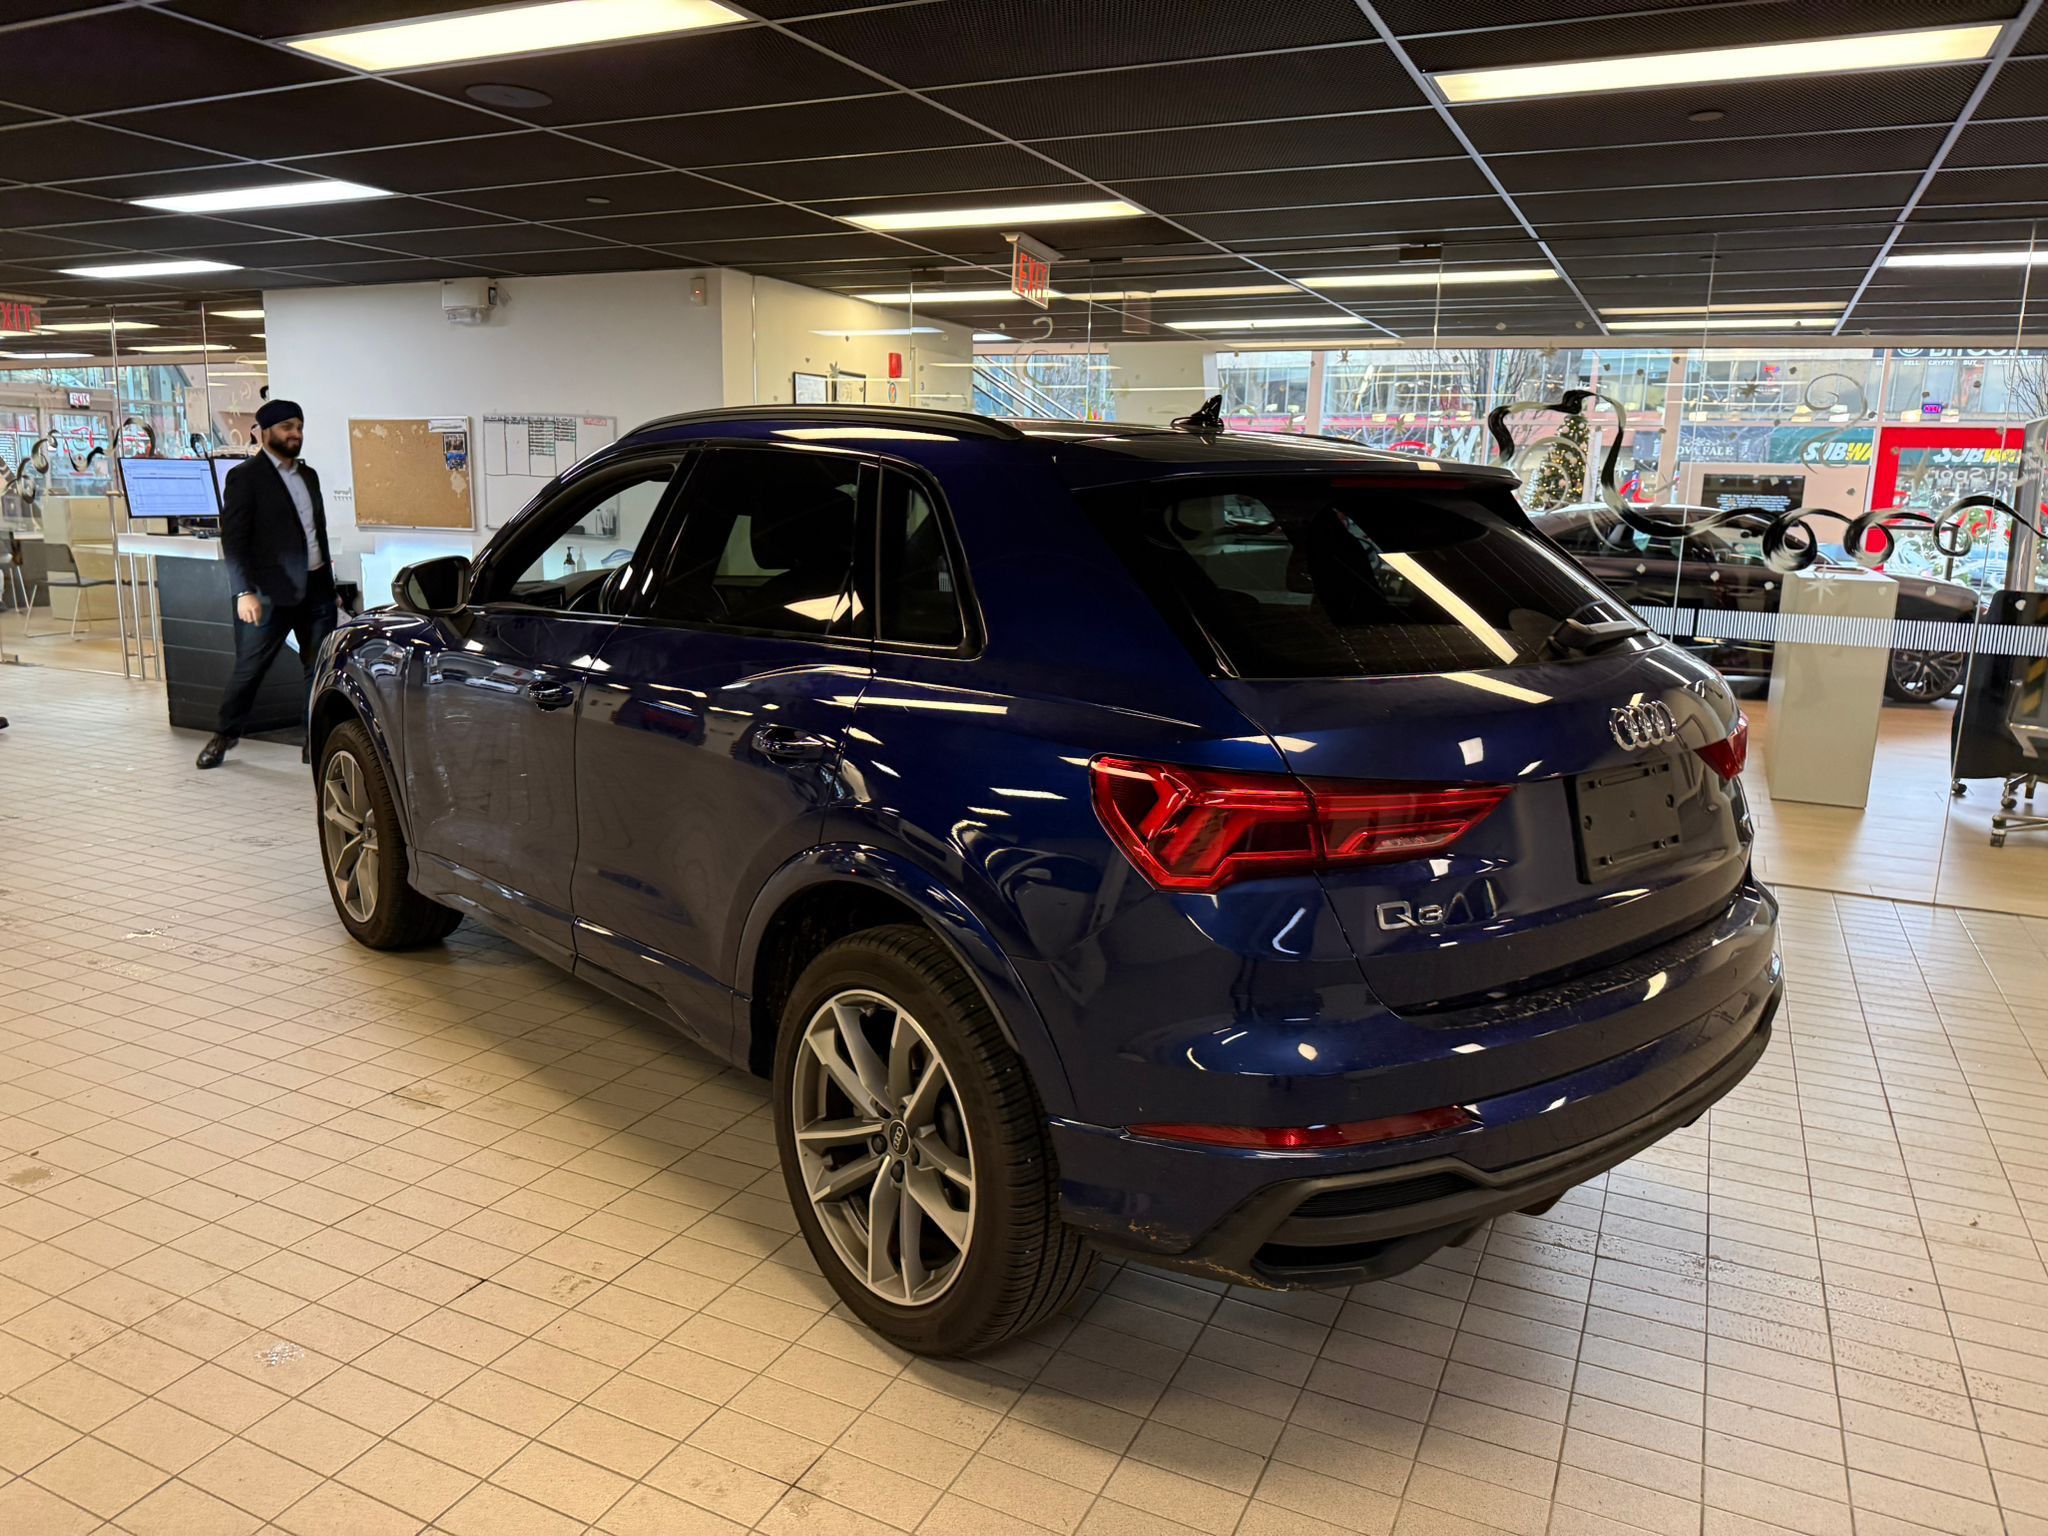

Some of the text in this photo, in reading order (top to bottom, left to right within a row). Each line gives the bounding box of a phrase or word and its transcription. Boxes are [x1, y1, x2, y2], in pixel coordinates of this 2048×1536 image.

[1018, 251, 1048, 305] EXIT
[0, 302, 32, 332] XIT
[1376, 900, 1443, 930] Q3
